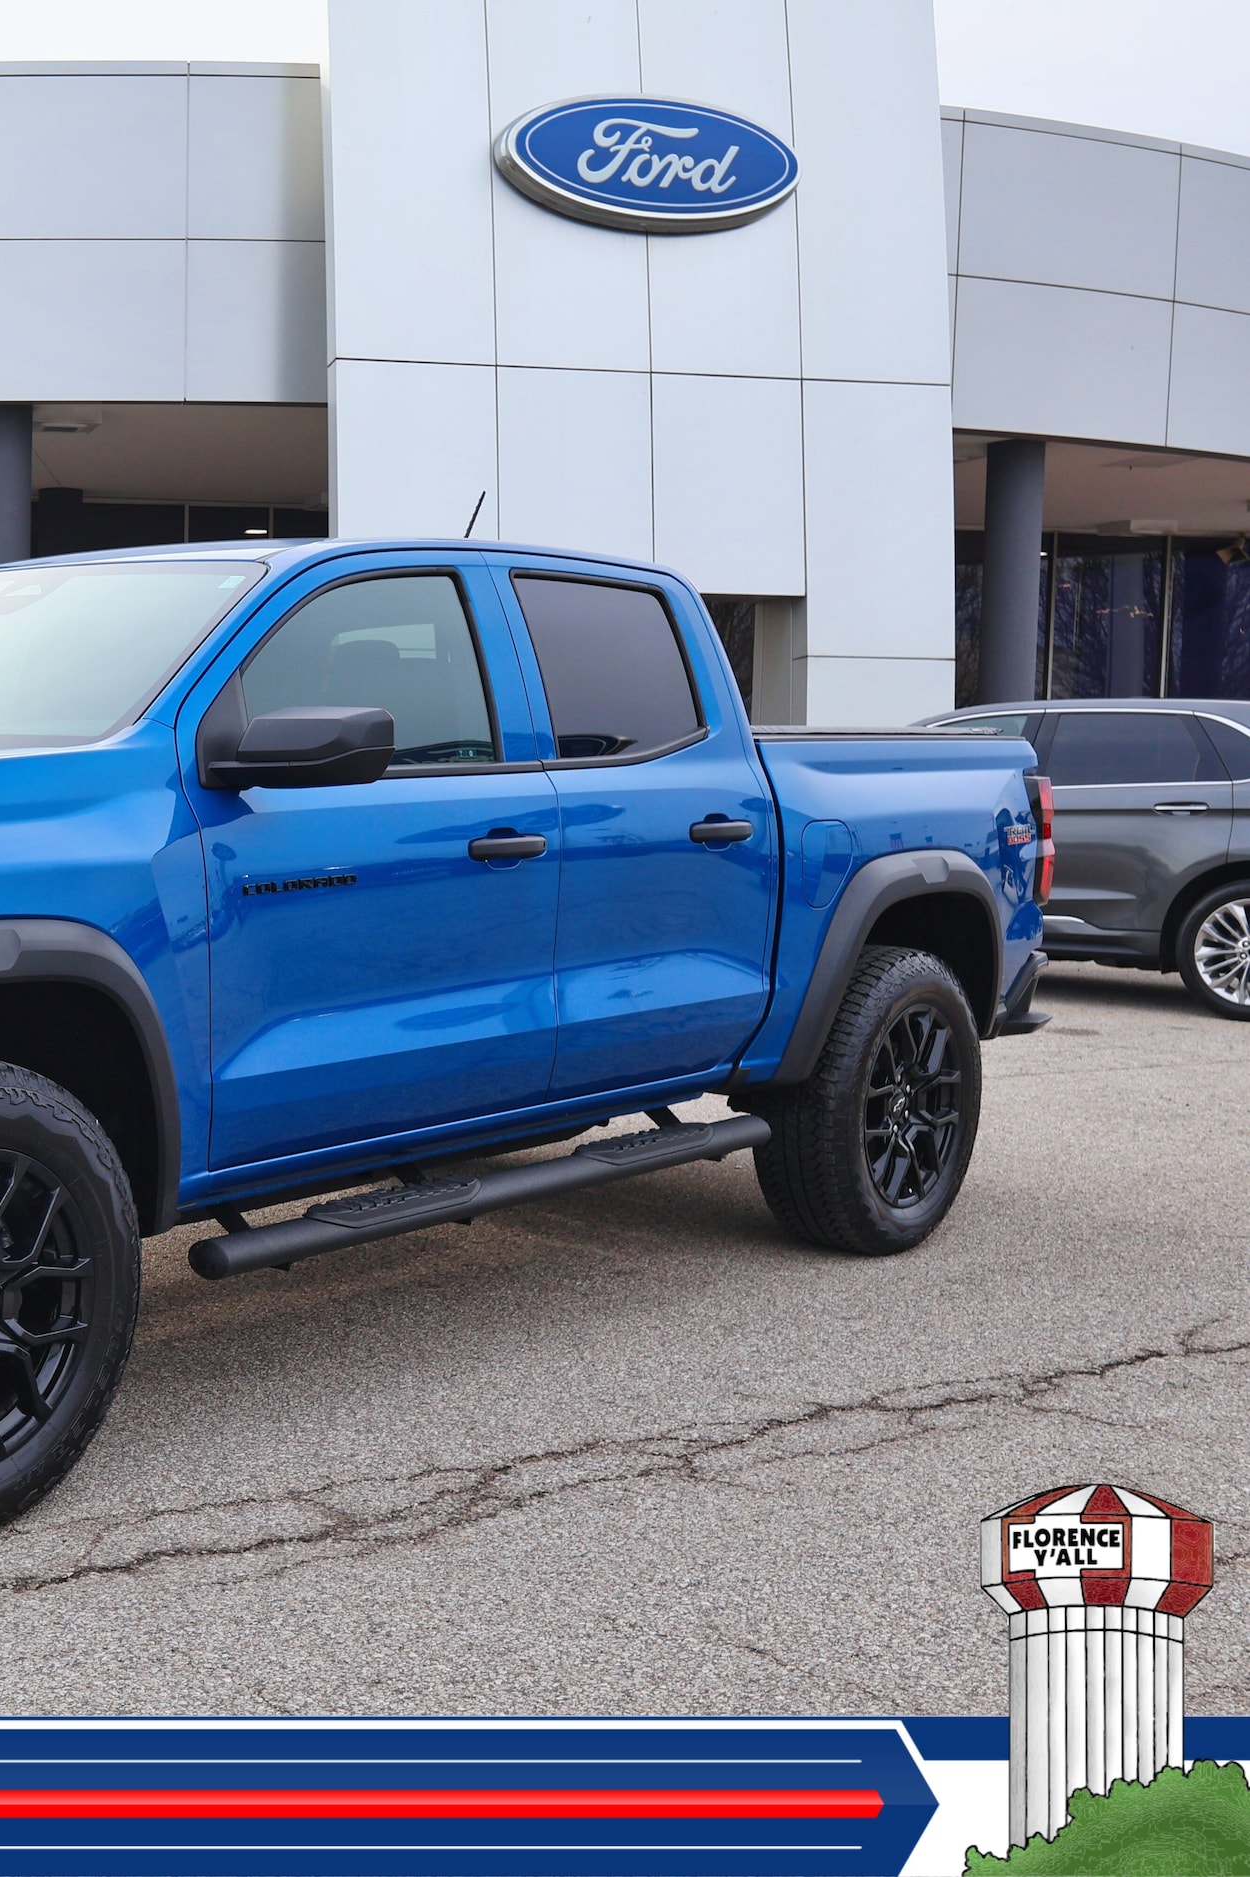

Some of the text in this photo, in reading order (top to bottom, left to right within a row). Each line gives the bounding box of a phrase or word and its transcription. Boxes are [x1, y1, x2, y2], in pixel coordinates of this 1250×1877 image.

[577, 117, 739, 194] Ford
[1003, 823, 1036, 836] TRAIL
[243, 873, 357, 896] COLORADO
